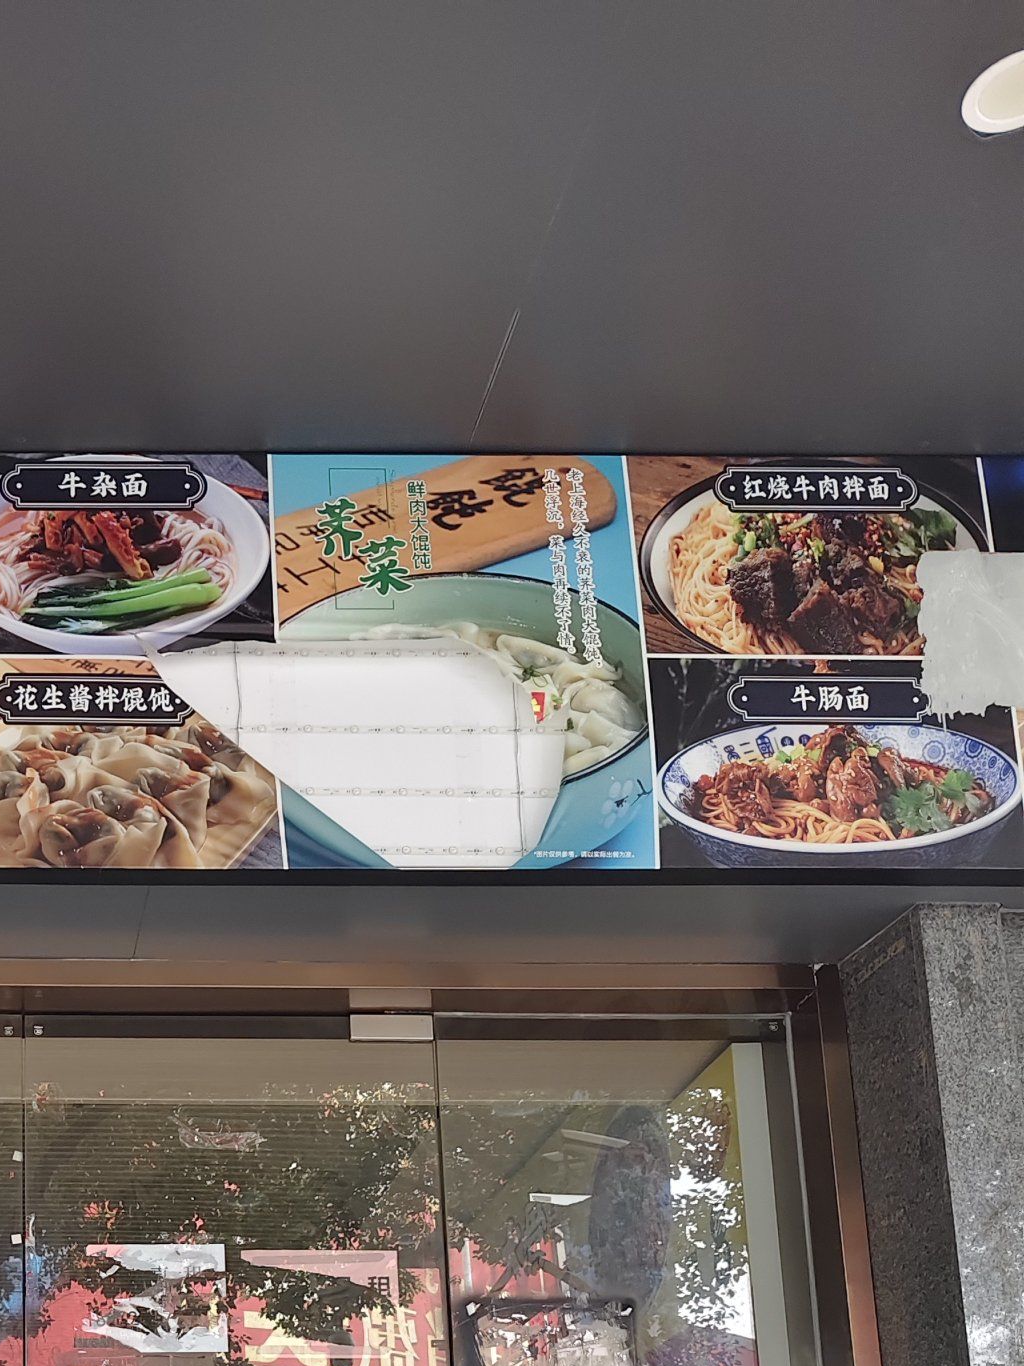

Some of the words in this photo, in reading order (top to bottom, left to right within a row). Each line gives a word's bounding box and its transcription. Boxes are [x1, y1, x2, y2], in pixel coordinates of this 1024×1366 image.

[58, 472, 148, 498] 牛杂面
[743, 475, 889, 500] 红烧牛肉拌面
[407, 480, 432, 570] 鲜肉大馄饨
[13, 684, 175, 712] 花生酱拌馄饨
[791, 685, 869, 711] 牛肠面
